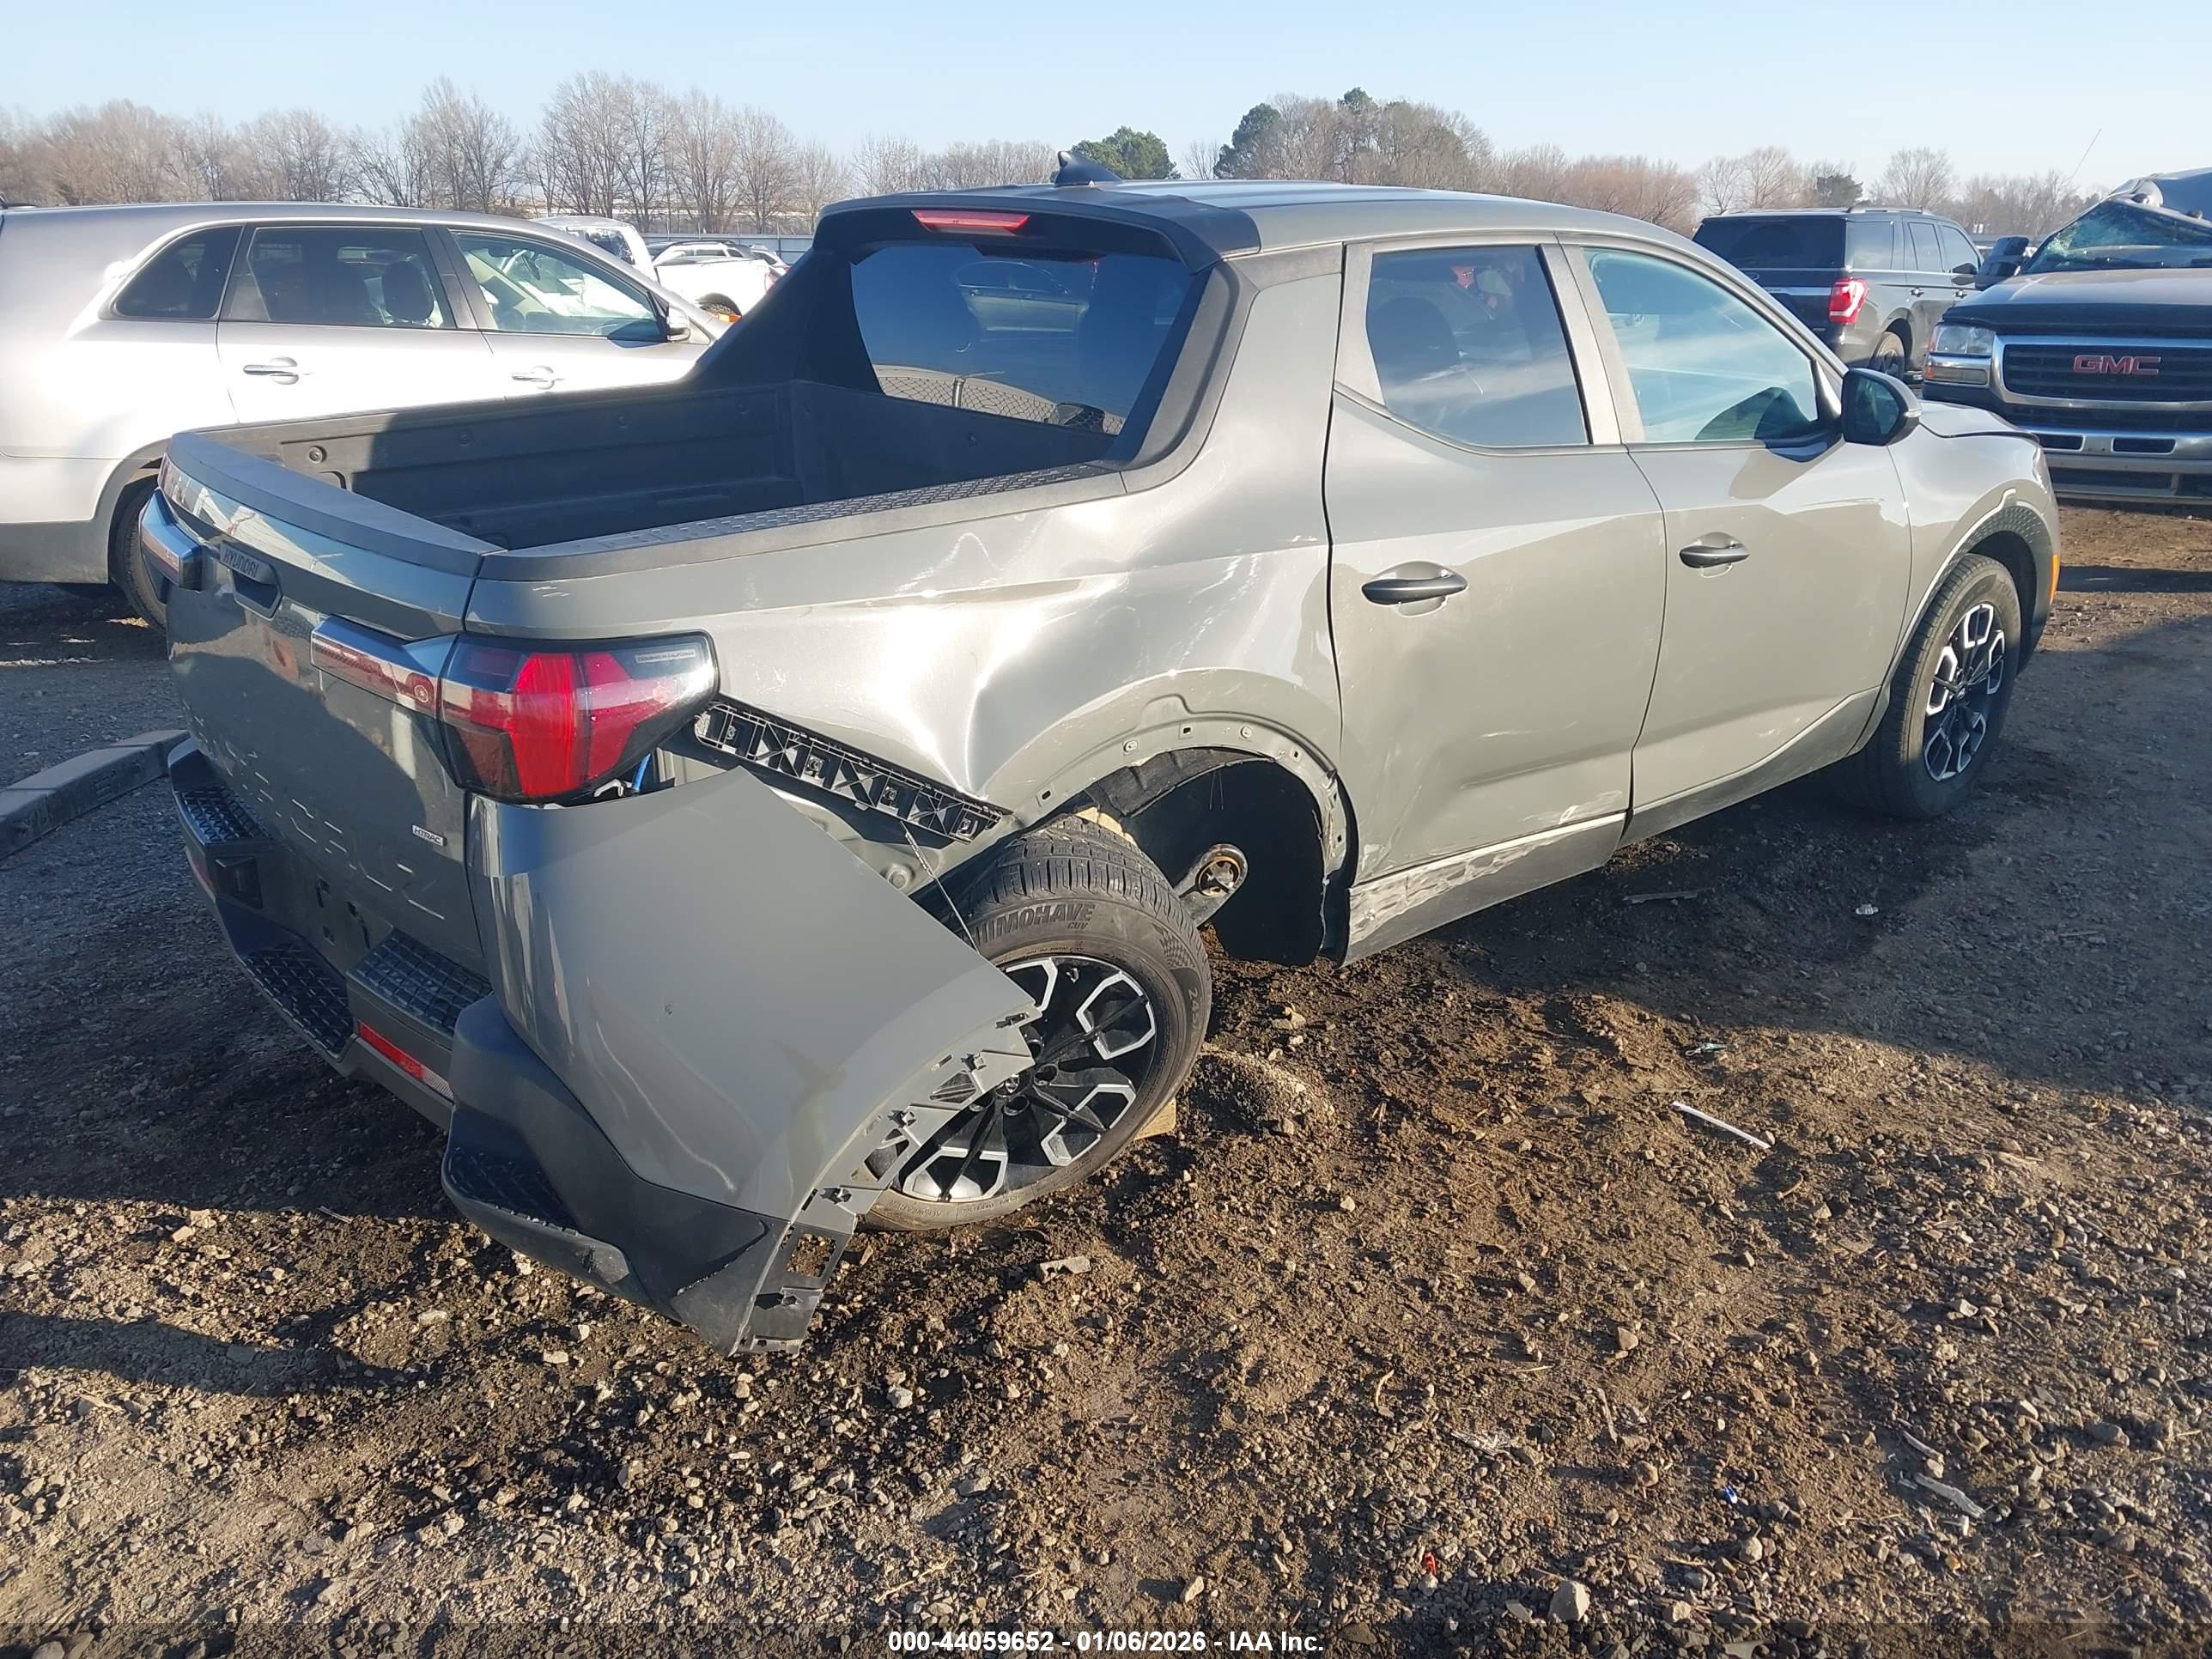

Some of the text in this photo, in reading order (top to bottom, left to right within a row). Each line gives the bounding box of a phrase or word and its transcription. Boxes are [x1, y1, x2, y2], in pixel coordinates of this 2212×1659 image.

[2074, 355, 2161, 374] GMC
[223, 548, 260, 578] HYUNDAI
[414, 827, 441, 844] HTRAC
[996, 903, 1095, 938] MOHAVE
